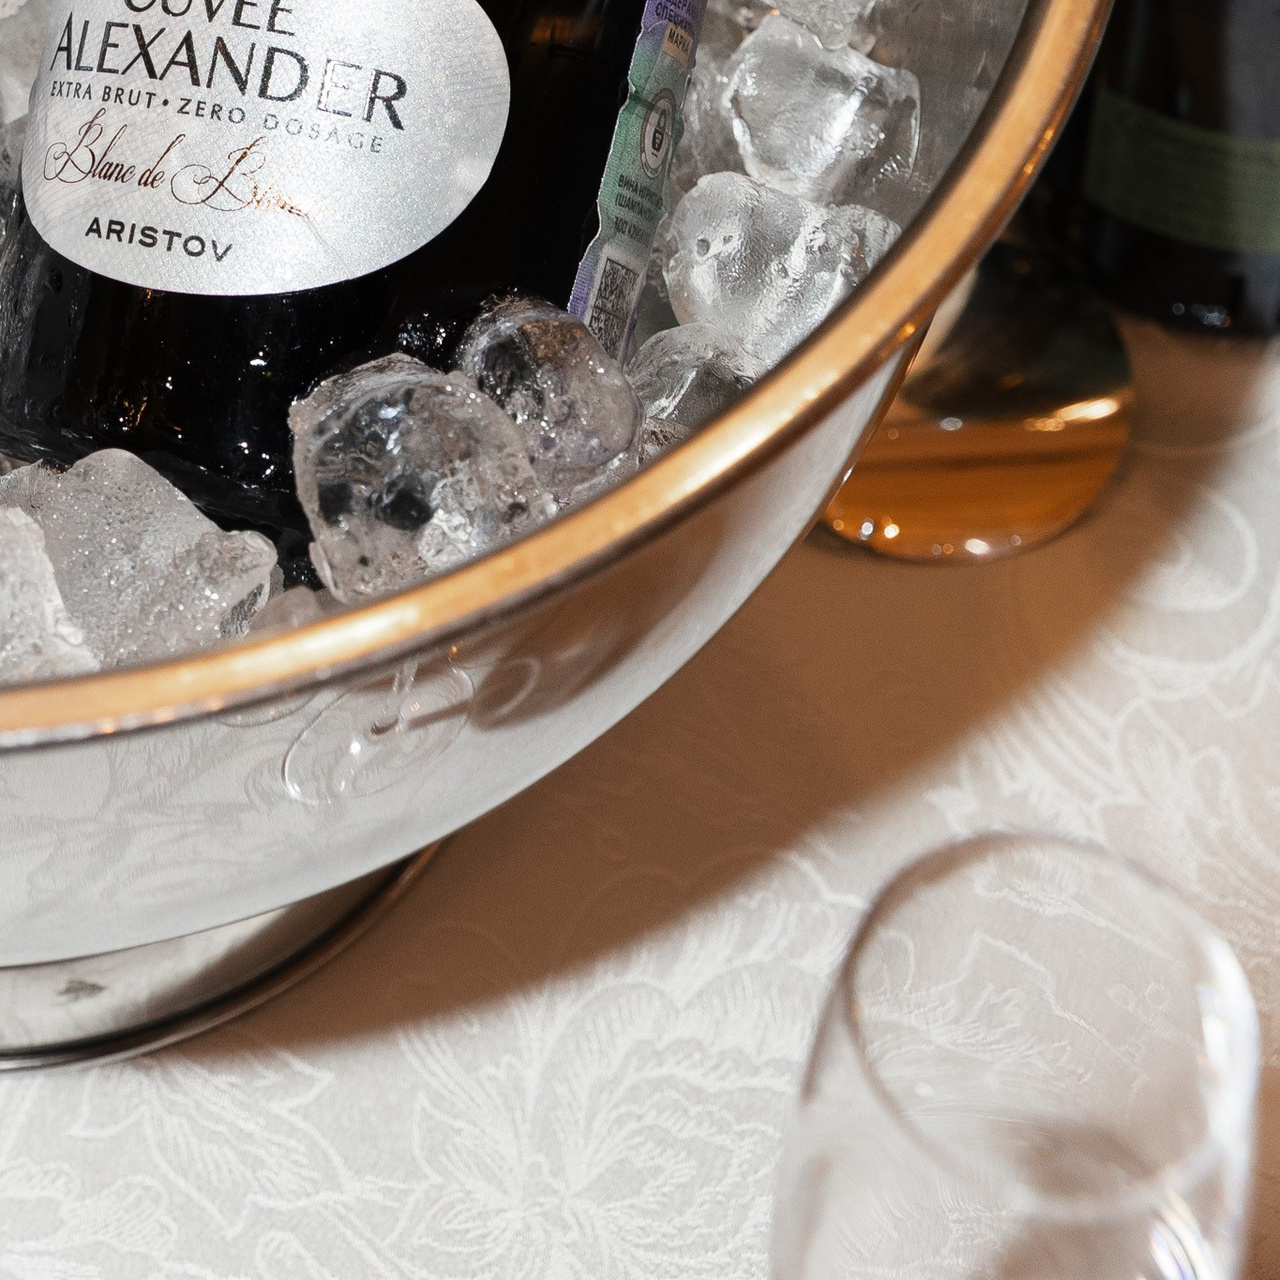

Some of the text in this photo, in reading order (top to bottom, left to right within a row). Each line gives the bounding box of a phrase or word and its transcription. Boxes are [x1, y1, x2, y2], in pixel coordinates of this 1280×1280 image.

[49, 11, 409, 132] ALEXANDER
[42, 107, 136, 184] Blanc
[137, 133, 186, 190] de
[49, 80, 385, 155] EXTRA BRUT ZERO DOSAGE
[84, 216, 235, 264] ARISTOV
